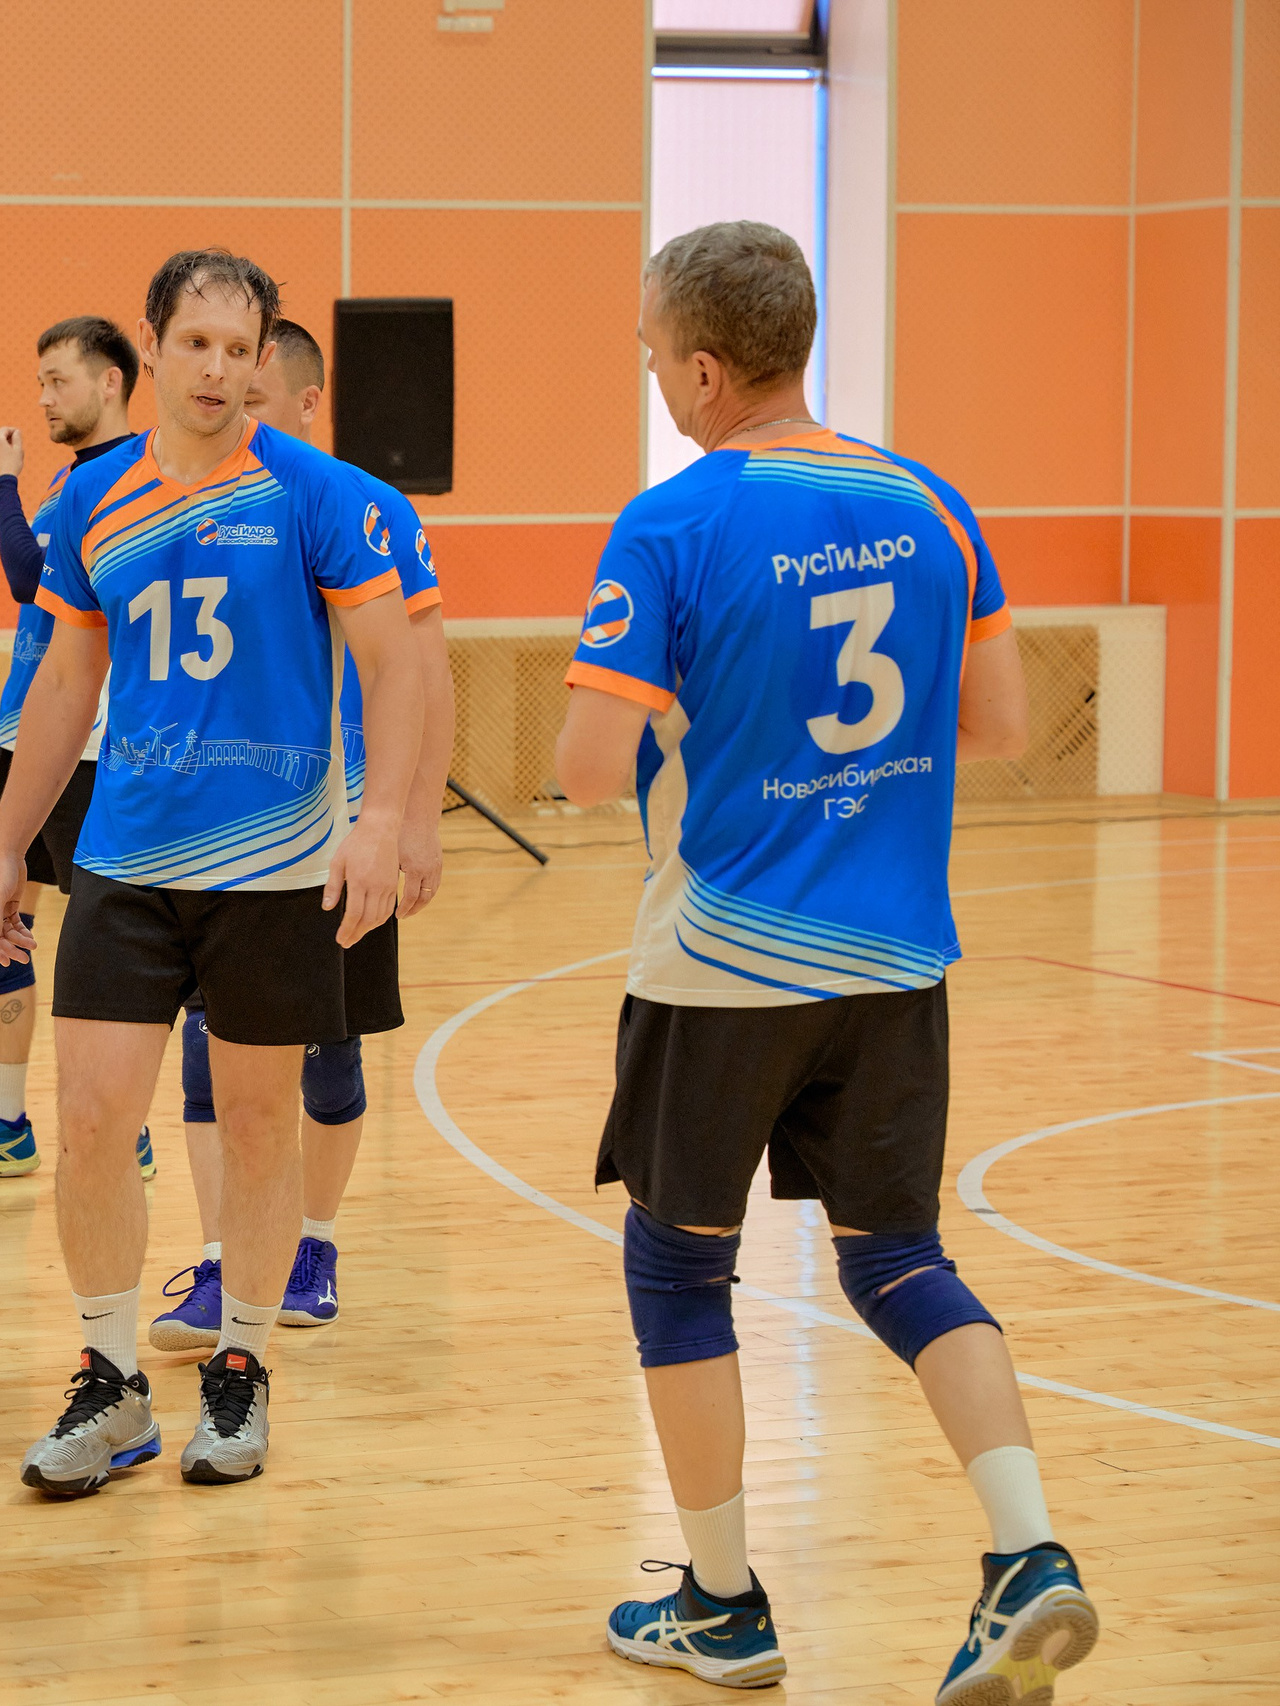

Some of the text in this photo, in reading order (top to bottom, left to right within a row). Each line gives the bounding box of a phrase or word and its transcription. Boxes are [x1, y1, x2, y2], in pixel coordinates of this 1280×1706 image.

[771, 534, 916, 587] РусГидро
[128, 576, 234, 681] 13
[806, 581, 906, 755] 3
[762, 756, 933, 800] Новосибирская
[823, 793, 870, 821] ГЭС
